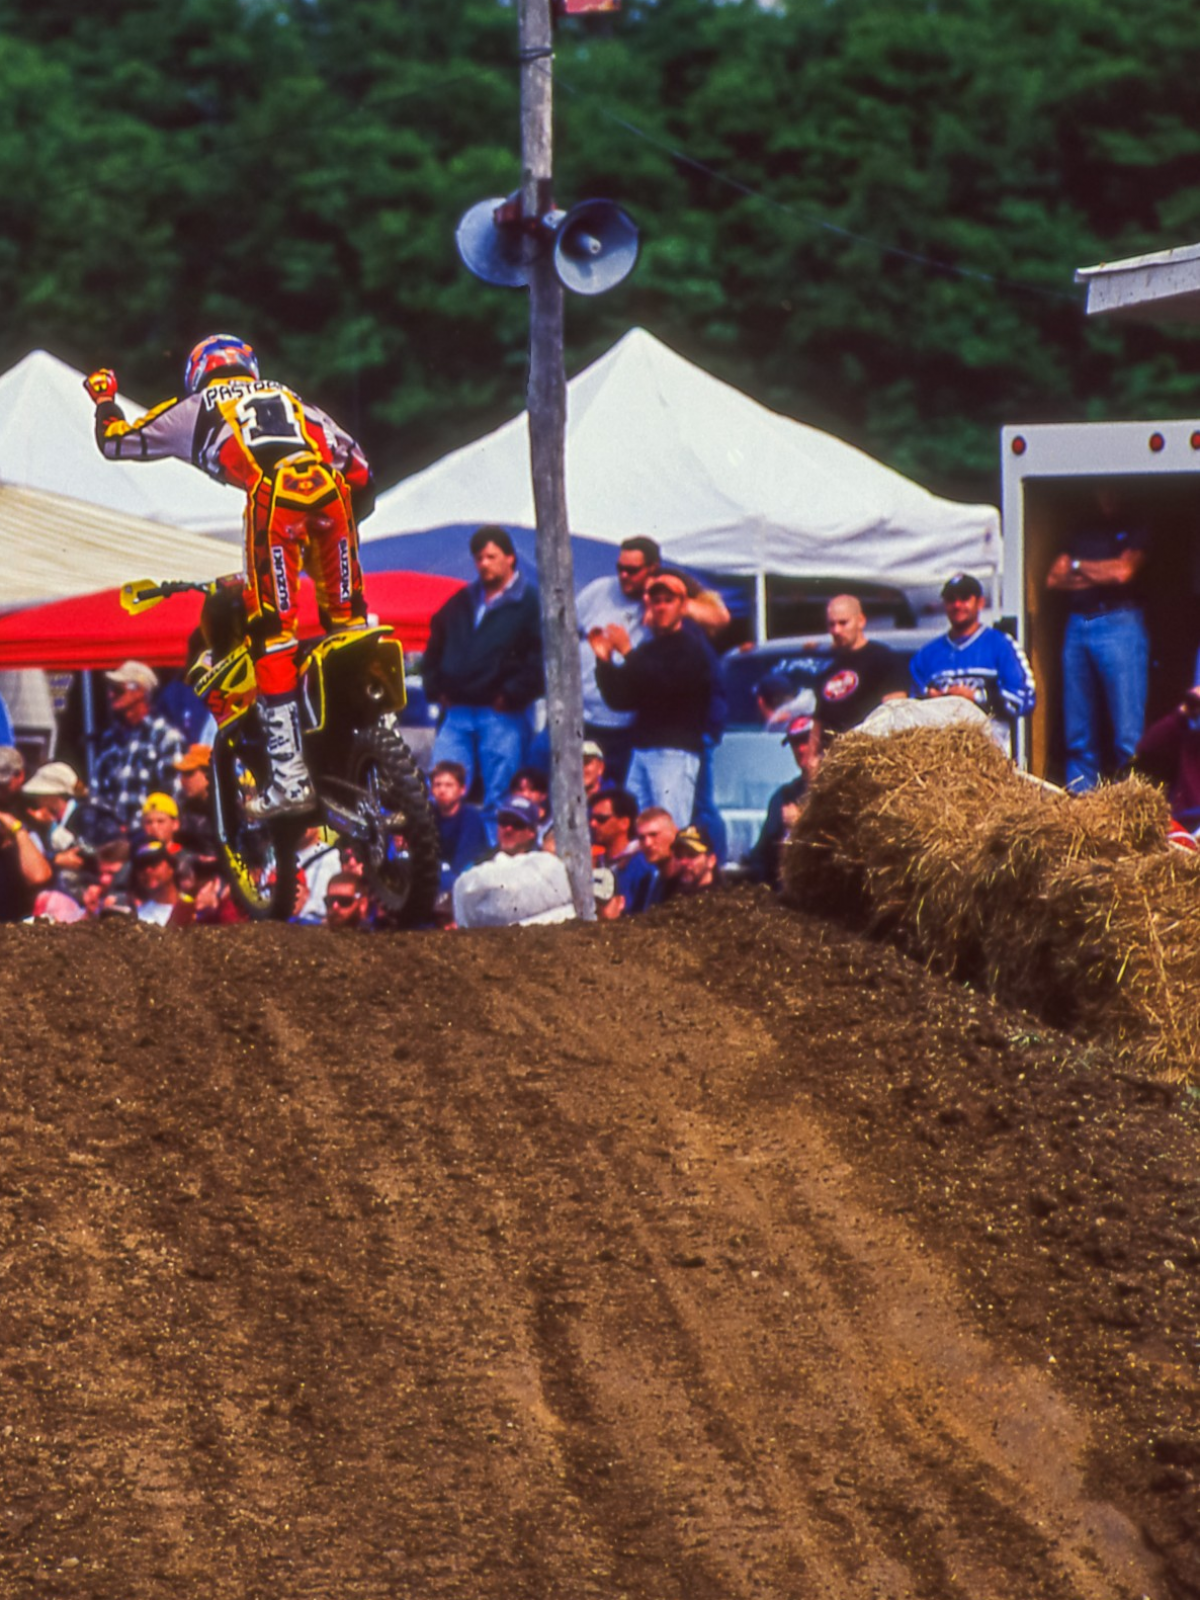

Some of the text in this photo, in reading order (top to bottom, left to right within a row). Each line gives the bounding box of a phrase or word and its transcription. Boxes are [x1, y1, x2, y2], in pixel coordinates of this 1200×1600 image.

[240, 393, 302, 443] 1
[272, 547, 290, 612] SUZUKI
[339, 537, 350, 601] SUZUKI
